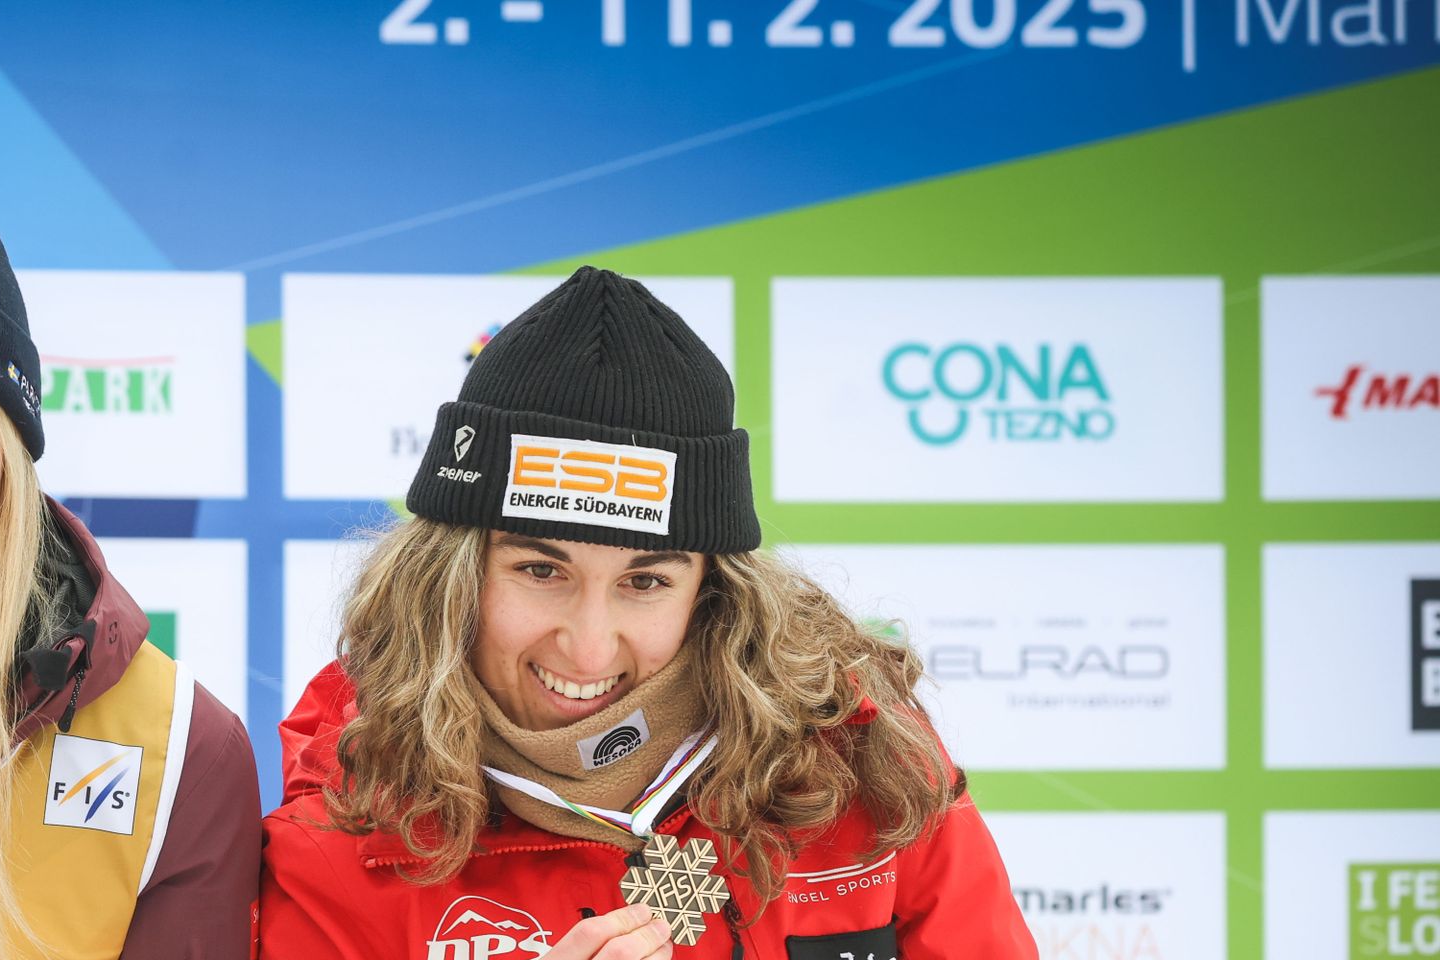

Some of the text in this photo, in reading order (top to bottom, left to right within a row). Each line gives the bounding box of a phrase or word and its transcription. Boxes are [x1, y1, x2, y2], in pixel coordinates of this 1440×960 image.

[882, 343, 1112, 402] CONA
[982, 408, 1116, 441] TEZNO
[512, 446, 668, 502] ESB
[509, 492, 664, 524] ENERGIE SÜDBAYERN
[928, 645, 1172, 680] ELRAD
[53, 782, 125, 810] FIS
[836, 871, 896, 896] SPORTS
